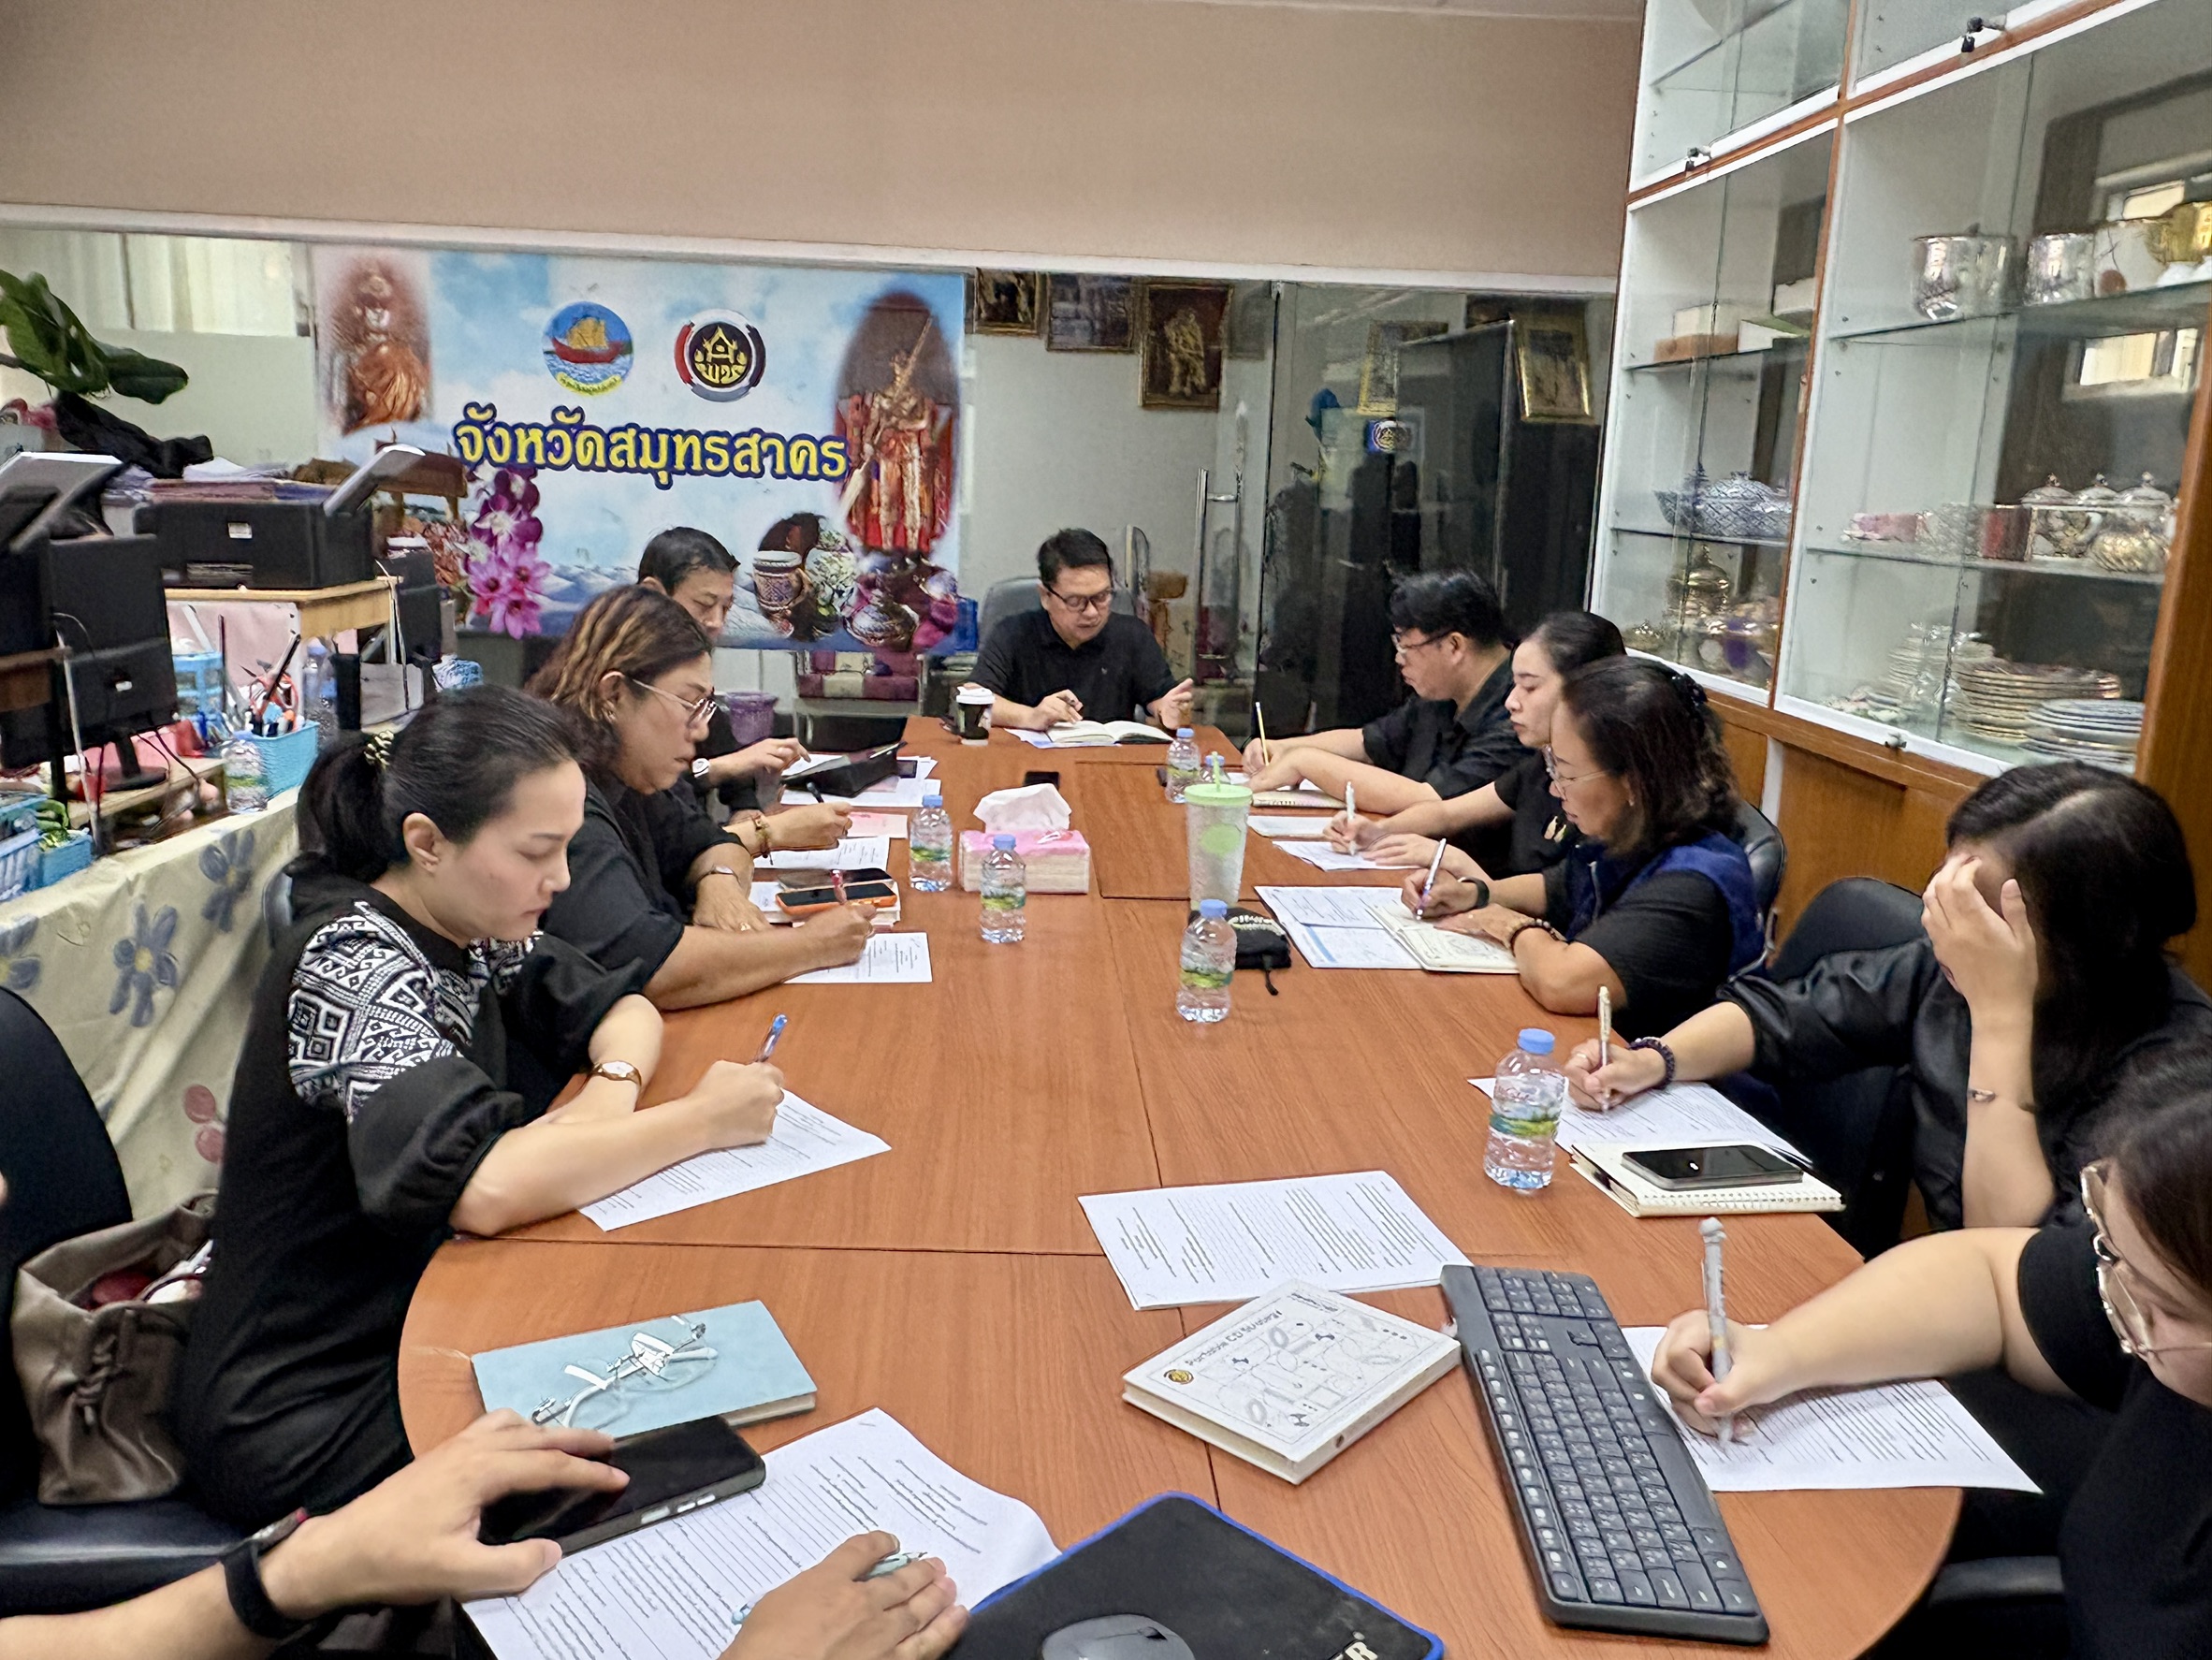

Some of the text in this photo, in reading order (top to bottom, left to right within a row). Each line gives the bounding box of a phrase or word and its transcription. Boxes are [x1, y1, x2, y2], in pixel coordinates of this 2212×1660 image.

[455, 402, 850, 488] จังหวัดสมุทรสาคร
